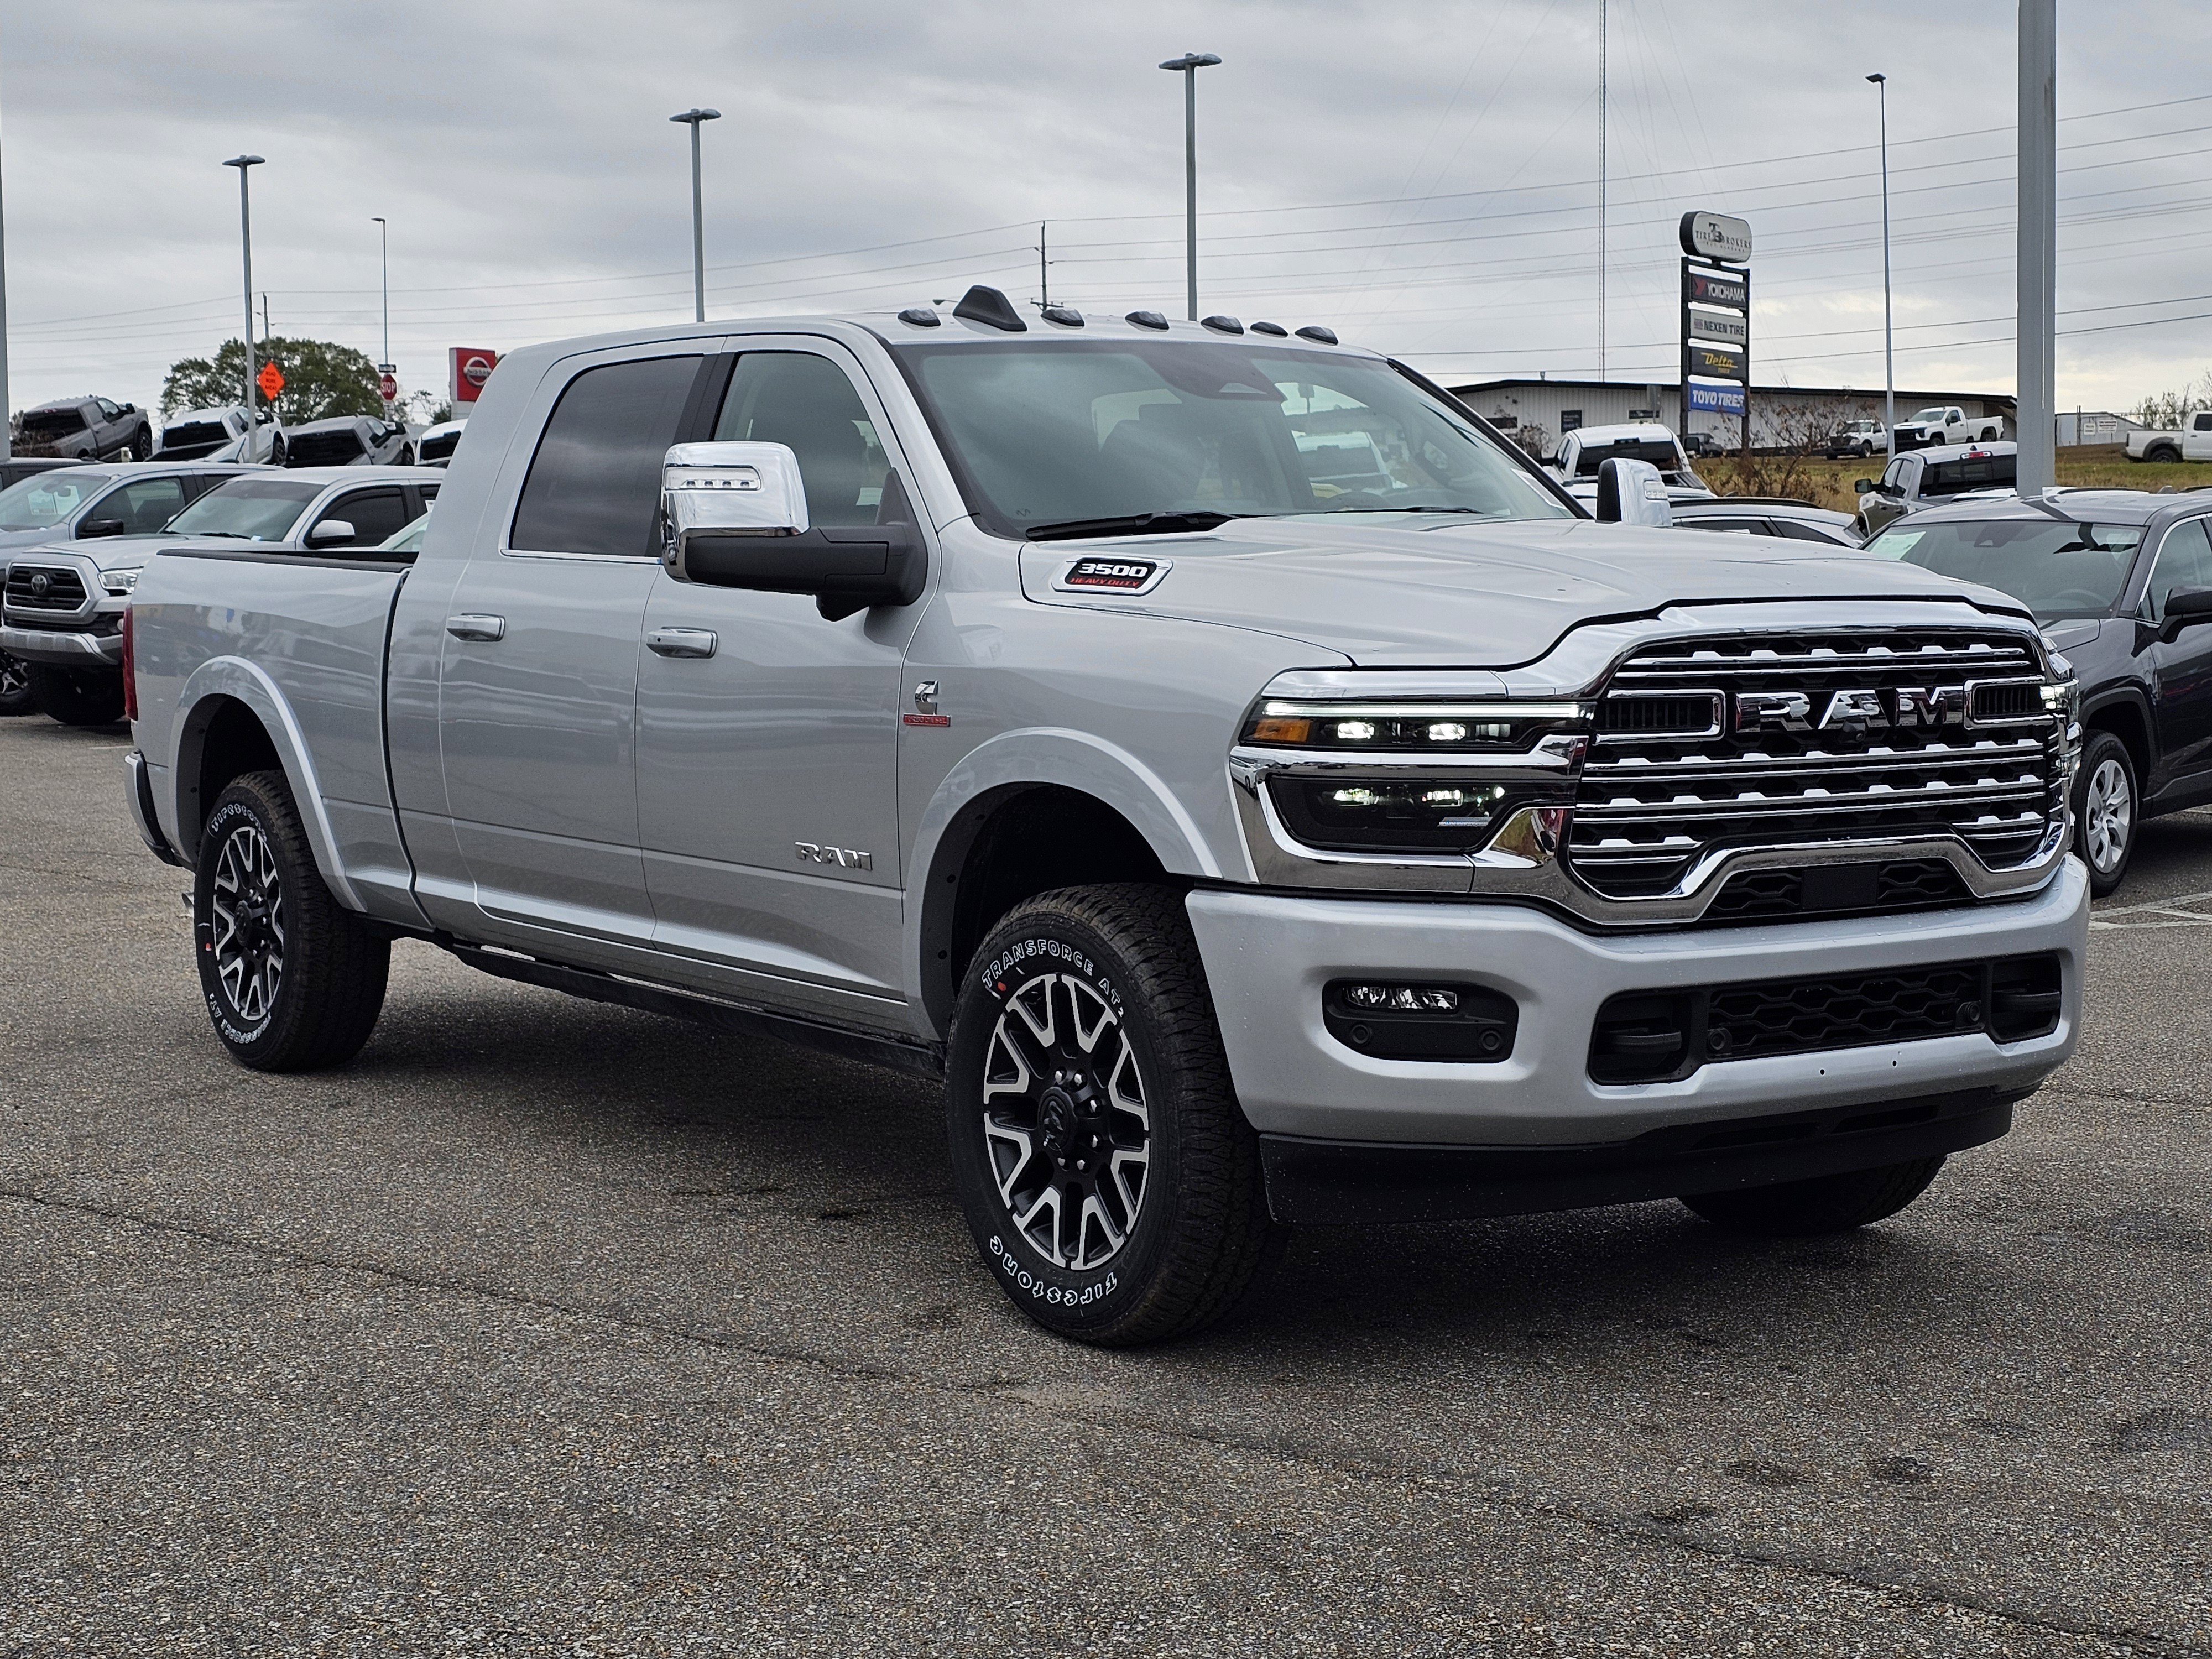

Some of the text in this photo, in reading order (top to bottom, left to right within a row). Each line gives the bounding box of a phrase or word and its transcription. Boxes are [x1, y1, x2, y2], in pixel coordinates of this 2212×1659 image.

[1695, 229, 1712, 241] TIRE
[1721, 235, 1752, 249] BROKERS
[1707, 281, 1746, 303] YOKOHAMA
[1704, 320, 1745, 336] NEXEN TIRE
[1700, 352, 1738, 369] Delta
[381, 381, 396, 394] STOP
[1692, 389, 1745, 408] TOYO TIRES
[1078, 563, 1149, 577] 3500
[1735, 685, 1964, 733] RAM
[794, 841, 873, 871] RAM
[981, 938, 1094, 989] TRANSFORCE
